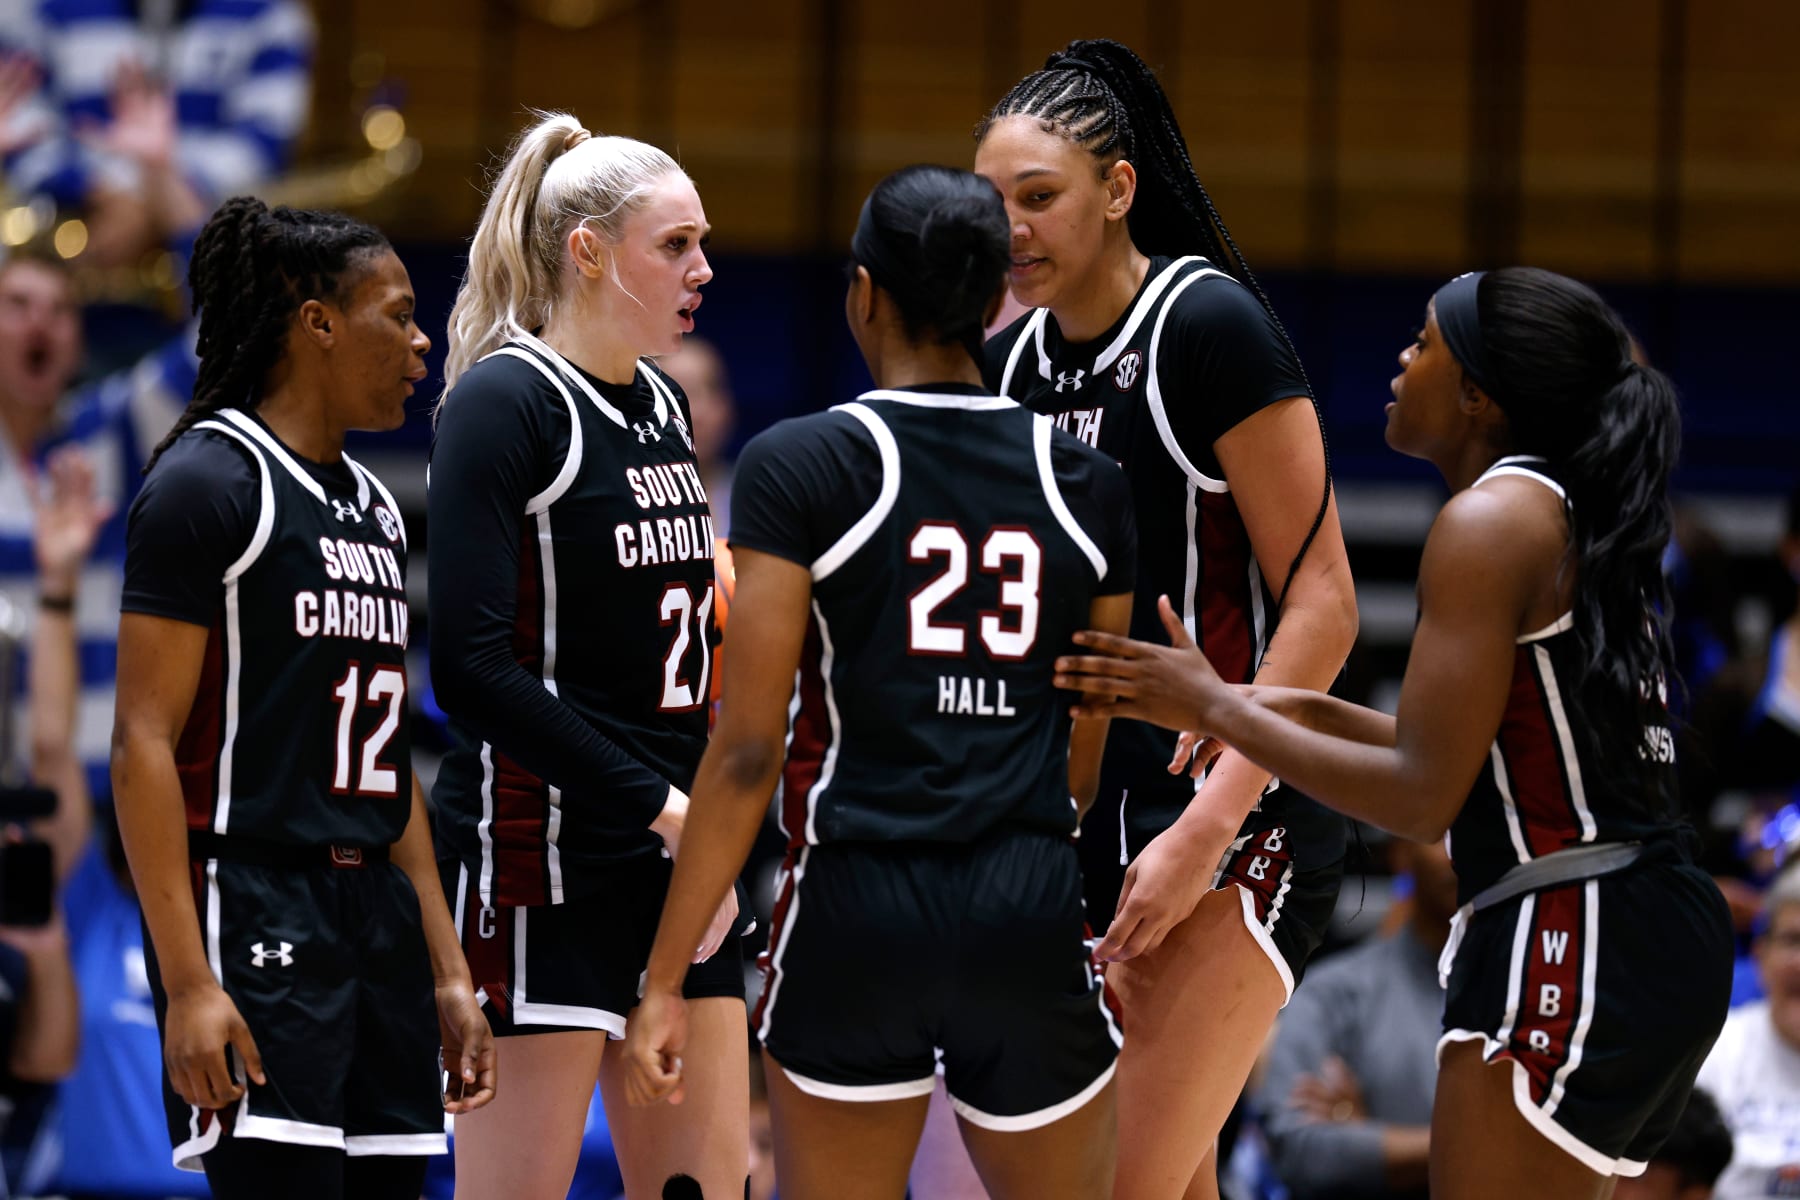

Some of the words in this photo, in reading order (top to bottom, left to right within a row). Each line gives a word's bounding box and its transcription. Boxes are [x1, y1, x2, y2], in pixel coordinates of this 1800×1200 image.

[1114, 352, 1141, 390] SEC
[625, 462, 708, 509] SOUTH
[318, 535, 404, 591] SOUTH
[907, 519, 1044, 661] 23
[657, 581, 714, 713] 21
[937, 675, 1016, 717] HALL
[331, 660, 407, 797] 12
